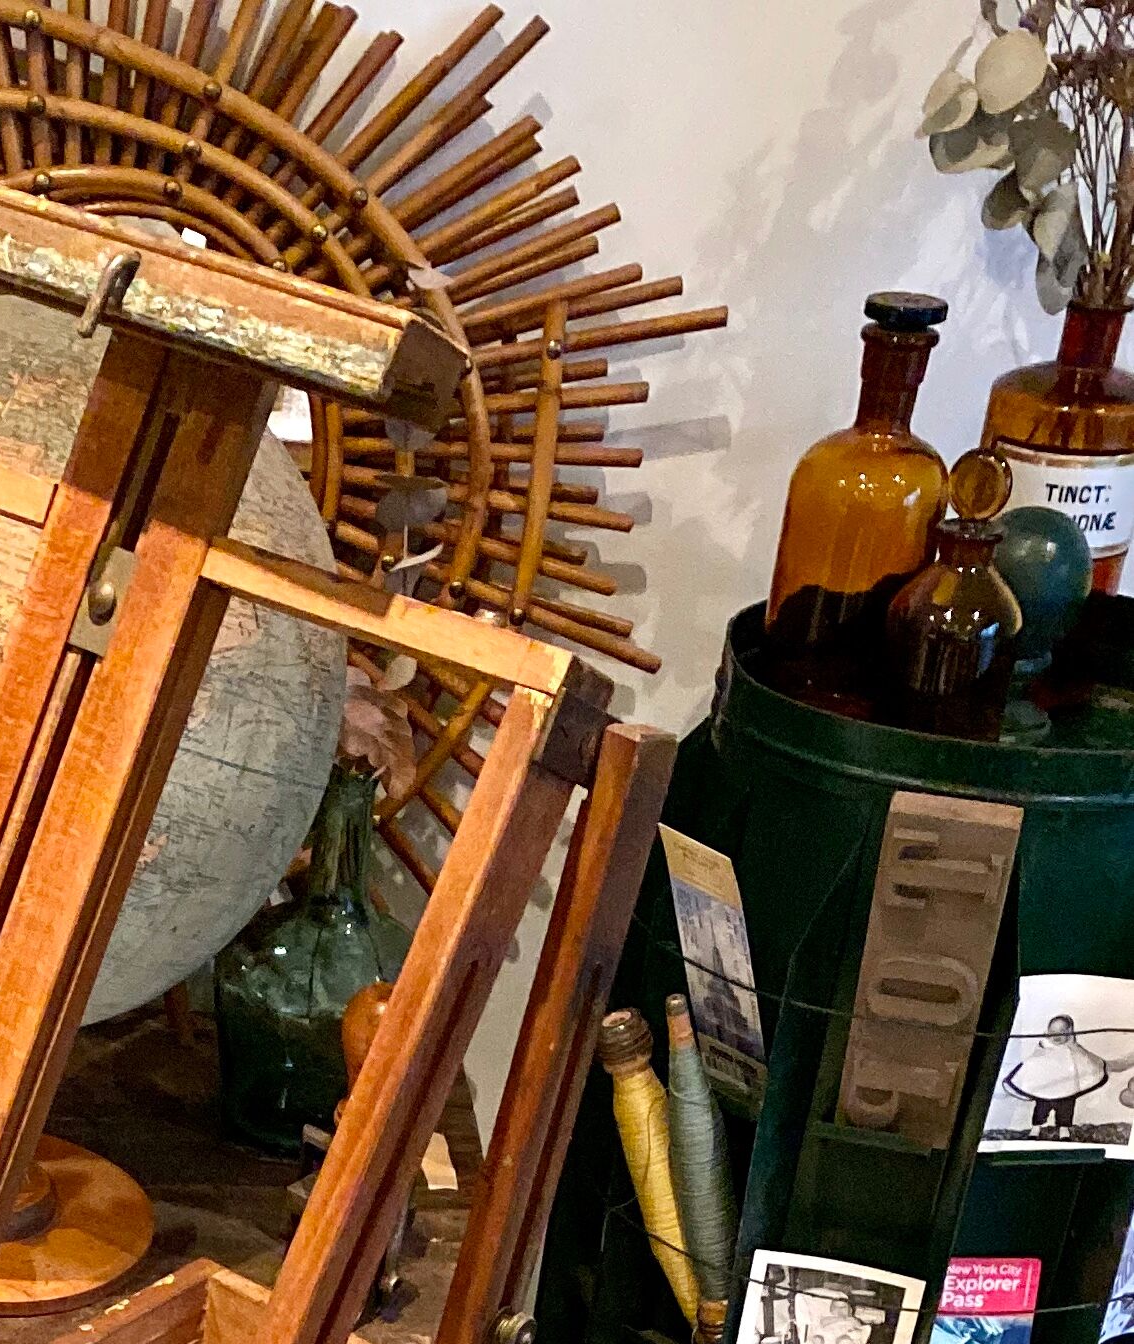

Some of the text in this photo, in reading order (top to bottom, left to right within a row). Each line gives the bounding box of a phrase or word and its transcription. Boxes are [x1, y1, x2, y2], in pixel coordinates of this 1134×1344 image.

[972, 1263, 999, 1276] York
[999, 1263, 1023, 1277] City
[944, 1275, 1021, 1294] Explorer
[940, 1291, 985, 1308] Pass
